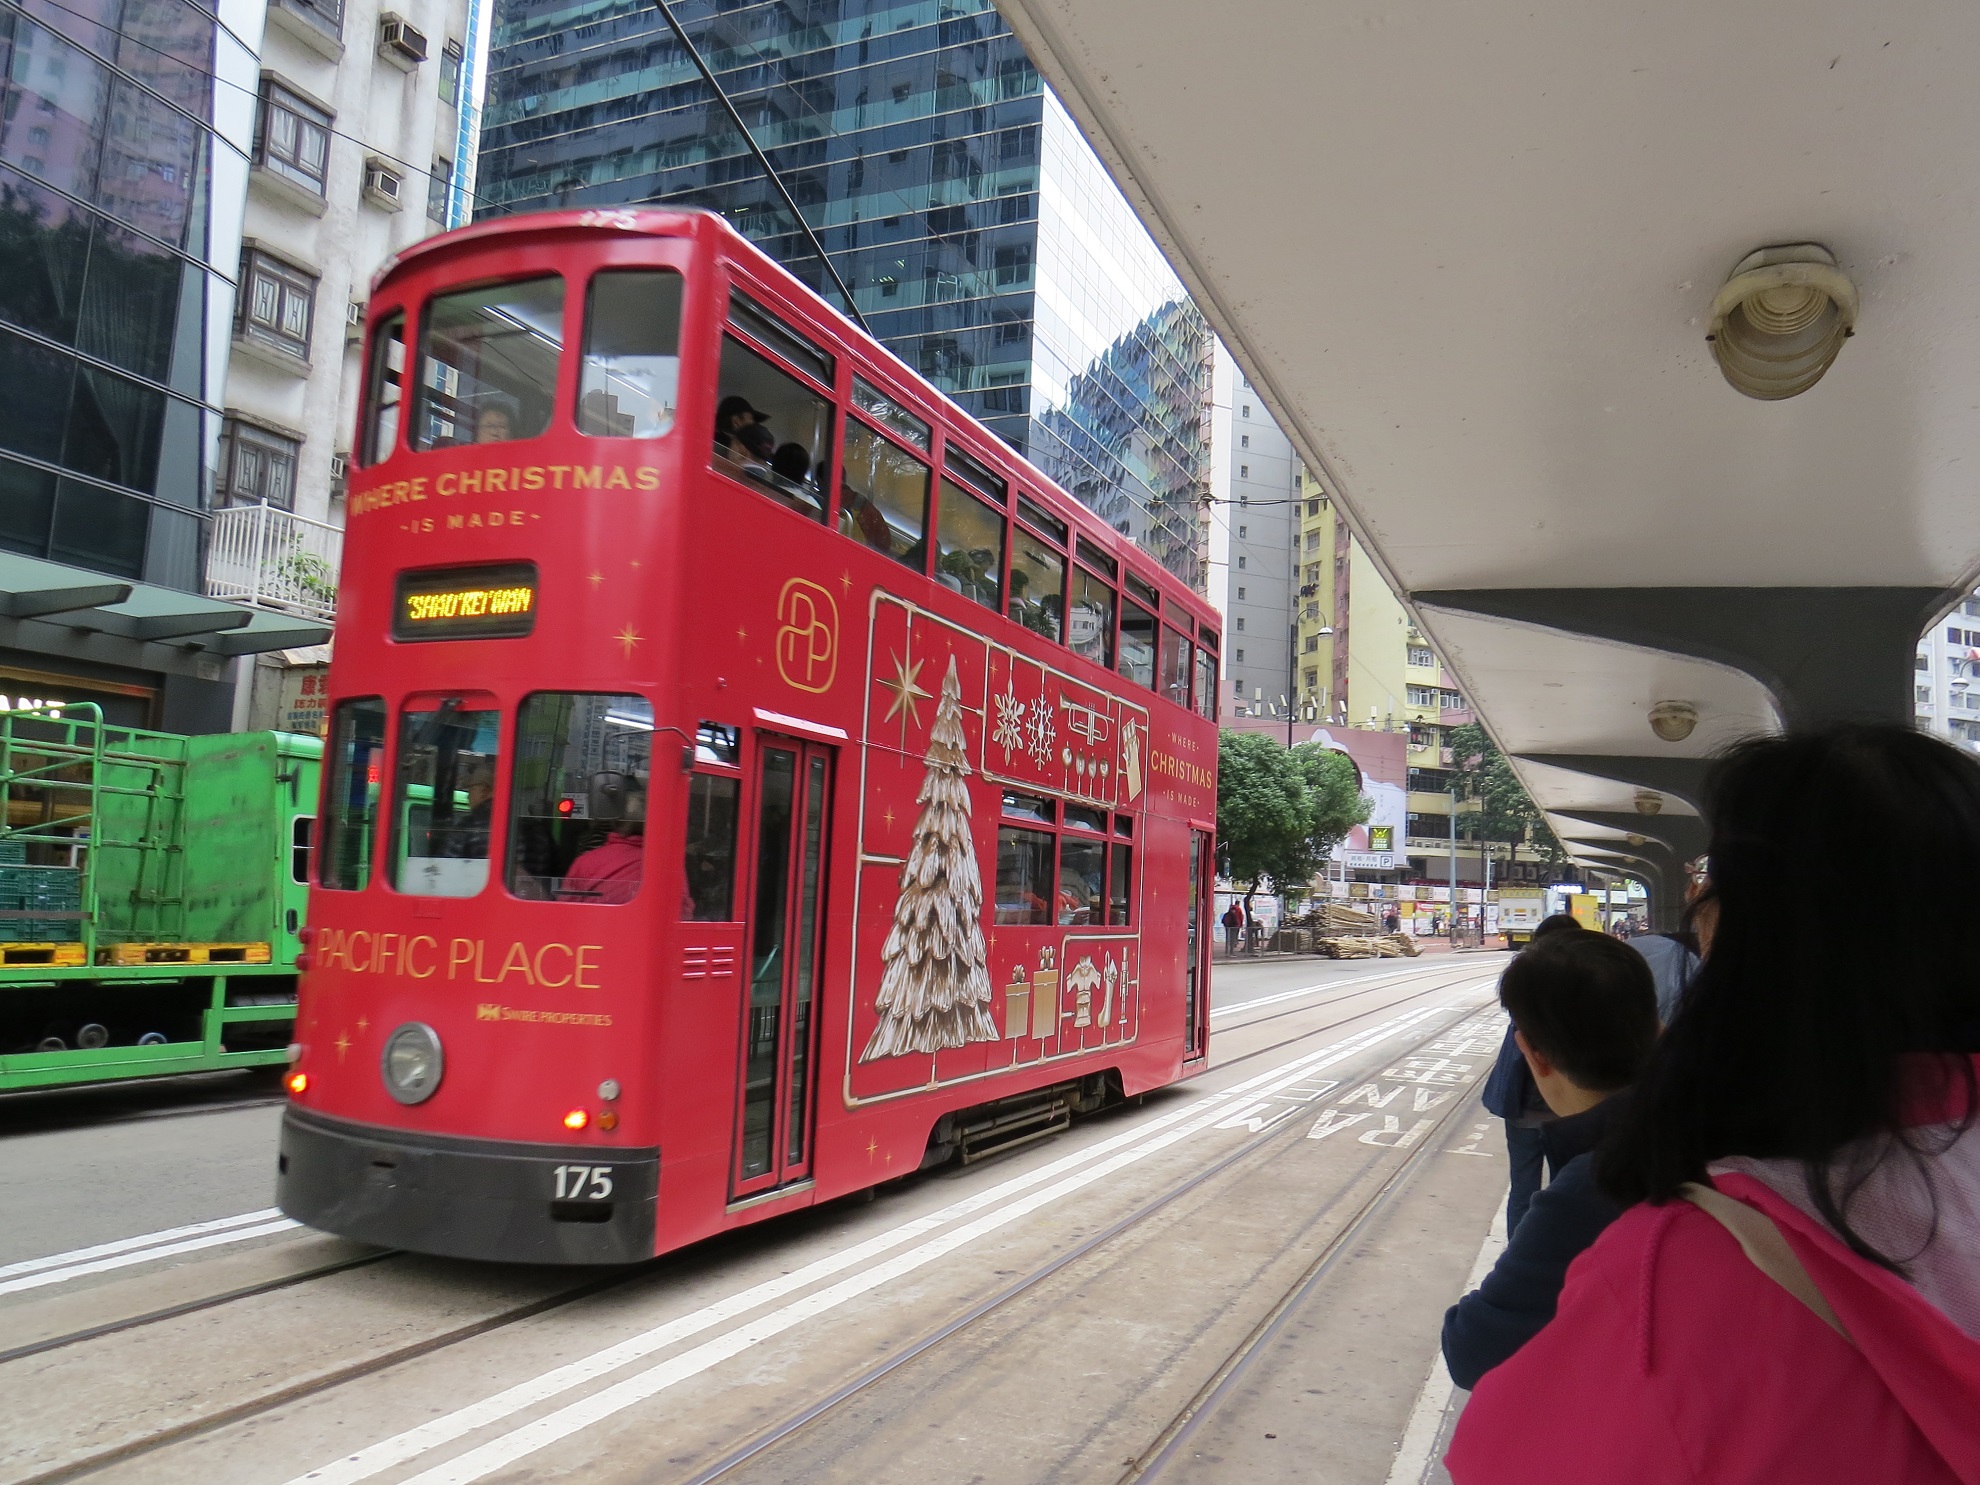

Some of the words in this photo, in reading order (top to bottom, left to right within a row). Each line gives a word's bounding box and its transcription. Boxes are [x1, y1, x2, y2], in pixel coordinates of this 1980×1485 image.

[350, 477, 429, 517] WHERE
[435, 465, 661, 497] CHRISTMAS
[411, 518, 434, 534] IS
[446, 510, 525, 530] MADE
[408, 593, 459, 620] SHAU
[458, 590, 489, 616] KEI
[489, 587, 532, 614] WAN
[1171, 732, 1196, 752] WHERE
[1151, 750, 1212, 789] CHRISTMAS
[1166, 789, 1174, 801] IS
[1178, 792, 1197, 807] MADE
[316, 928, 438, 979] PACIFIC
[448, 938, 604, 989] PLACE
[540, 1011, 613, 1026] PROPERTIES
[553, 1165, 614, 1200] 175
